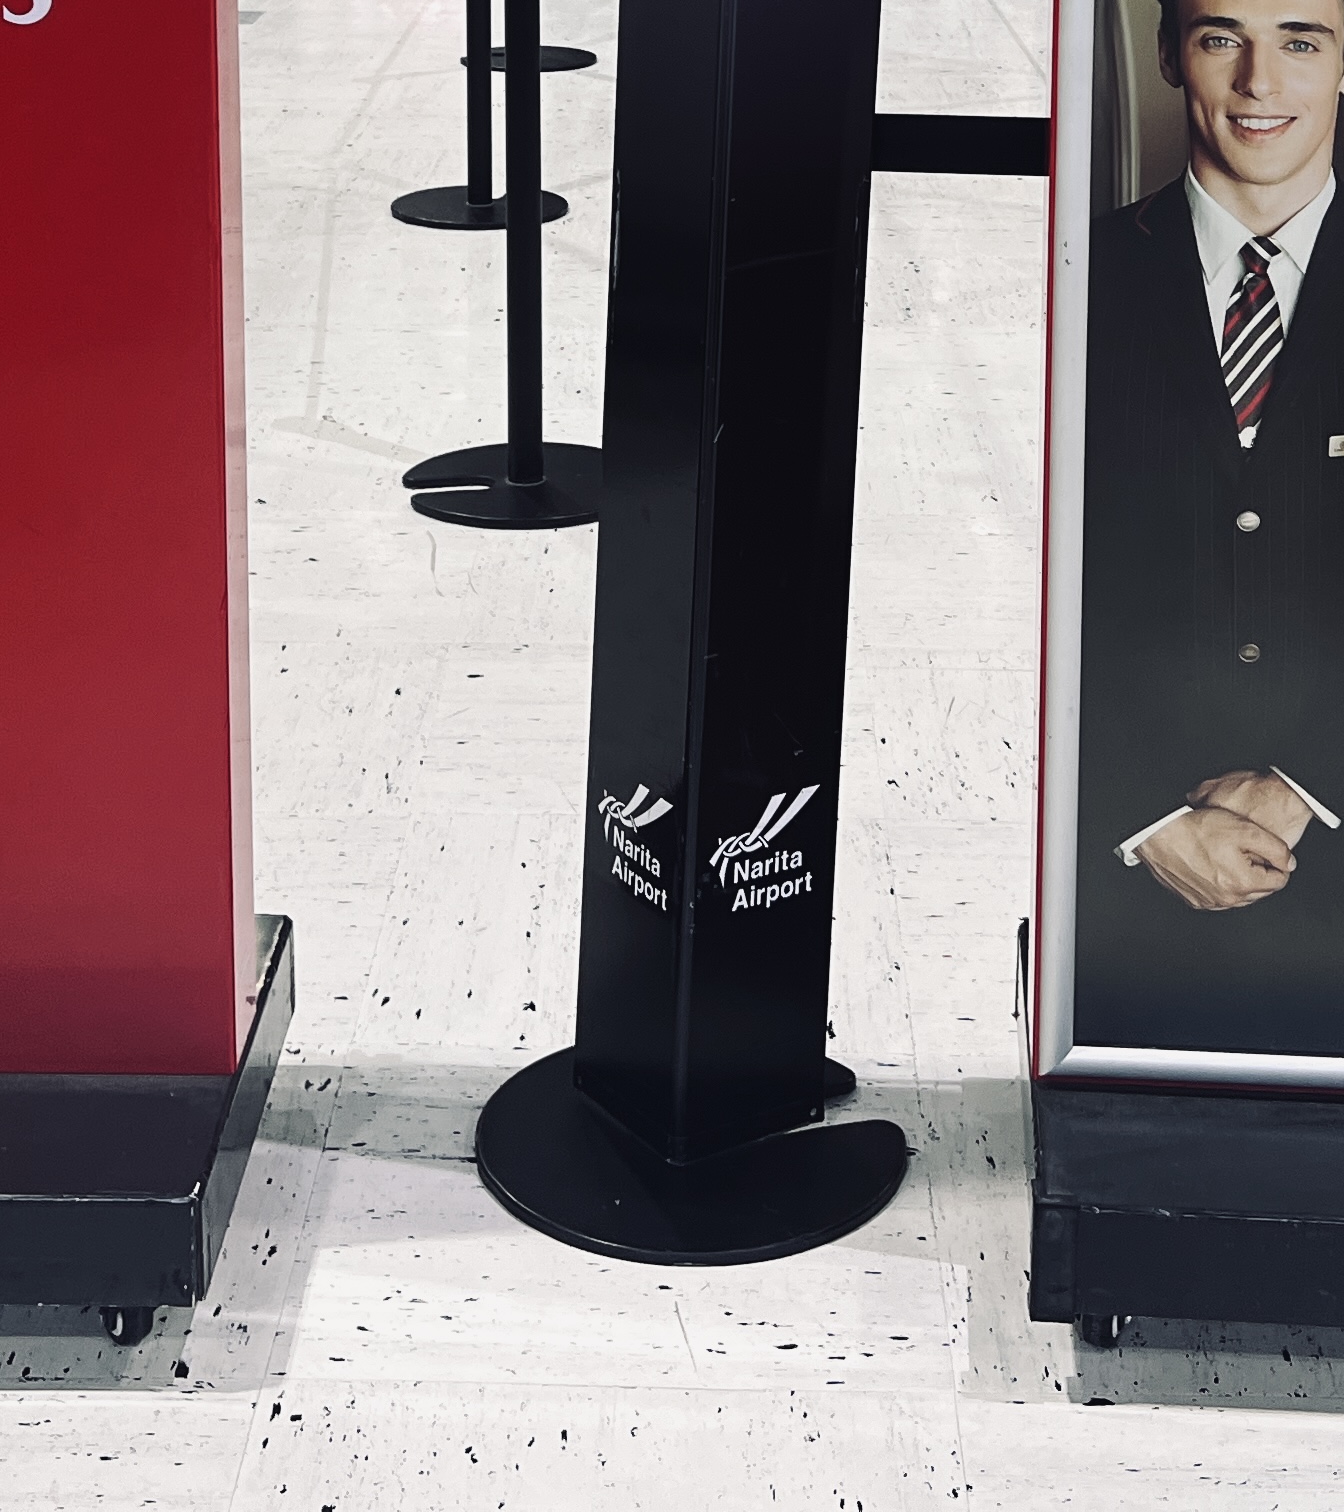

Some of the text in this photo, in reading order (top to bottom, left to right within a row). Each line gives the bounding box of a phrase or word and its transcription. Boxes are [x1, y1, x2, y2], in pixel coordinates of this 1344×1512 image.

[613, 825, 661, 878] Narita
[733, 850, 803, 884] Narita
[611, 855, 668, 911] Airport
[731, 871, 813, 912] Airport
